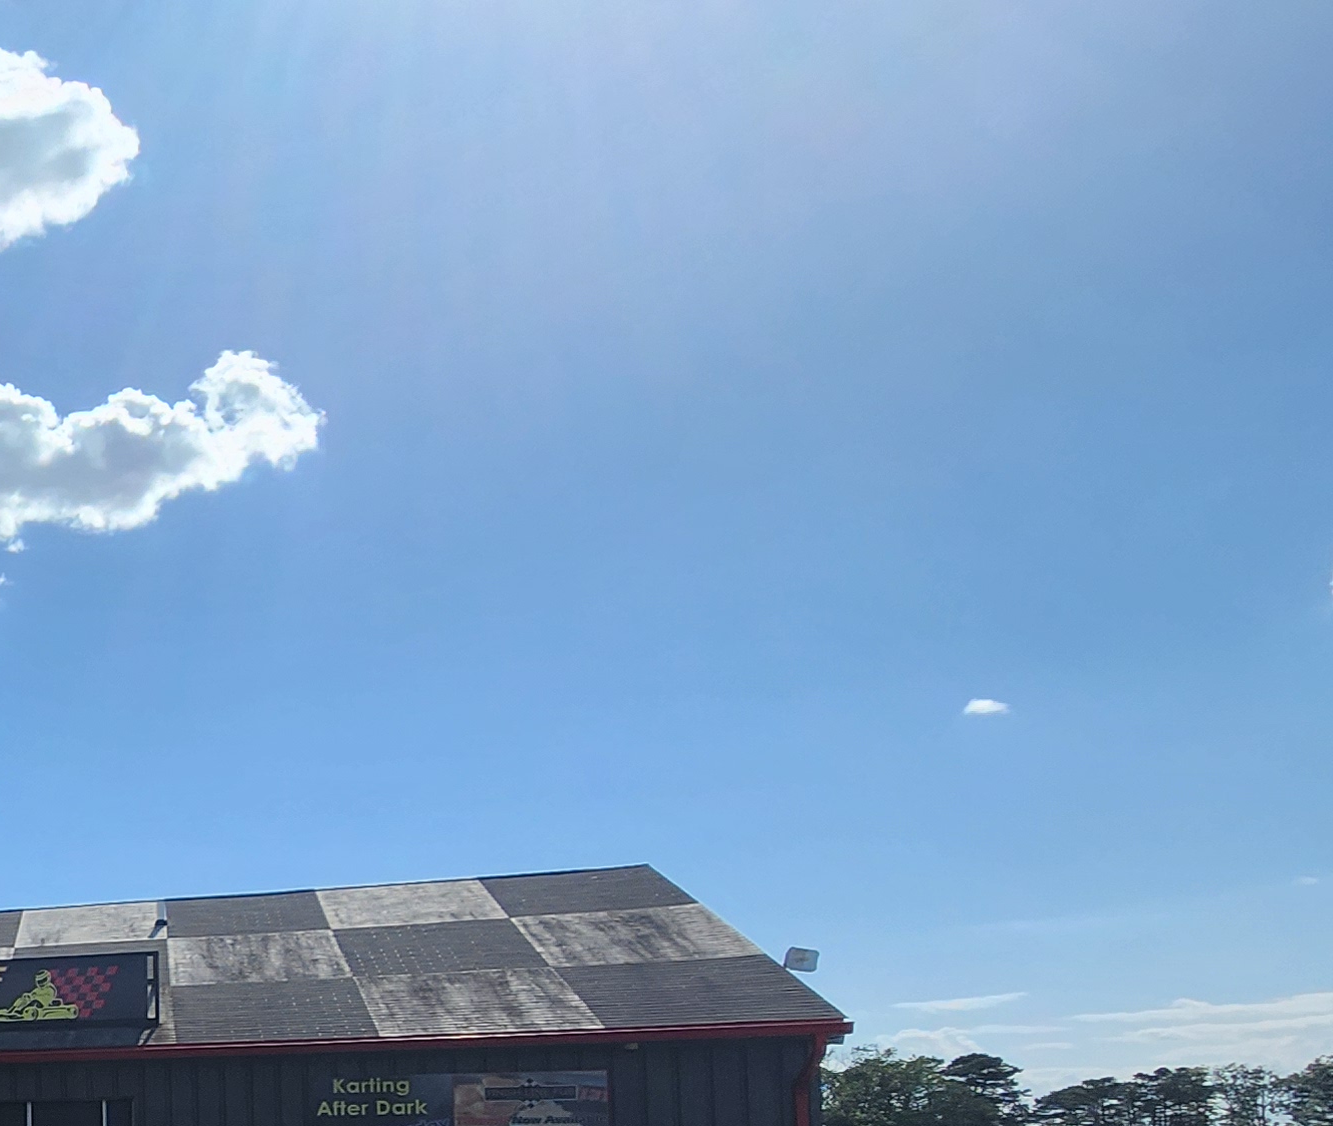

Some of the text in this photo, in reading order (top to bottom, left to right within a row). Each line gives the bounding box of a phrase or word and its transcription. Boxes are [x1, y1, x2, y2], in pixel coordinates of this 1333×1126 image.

[333, 1077, 410, 1096] Karting
[316, 1099, 428, 1116] After Dark
